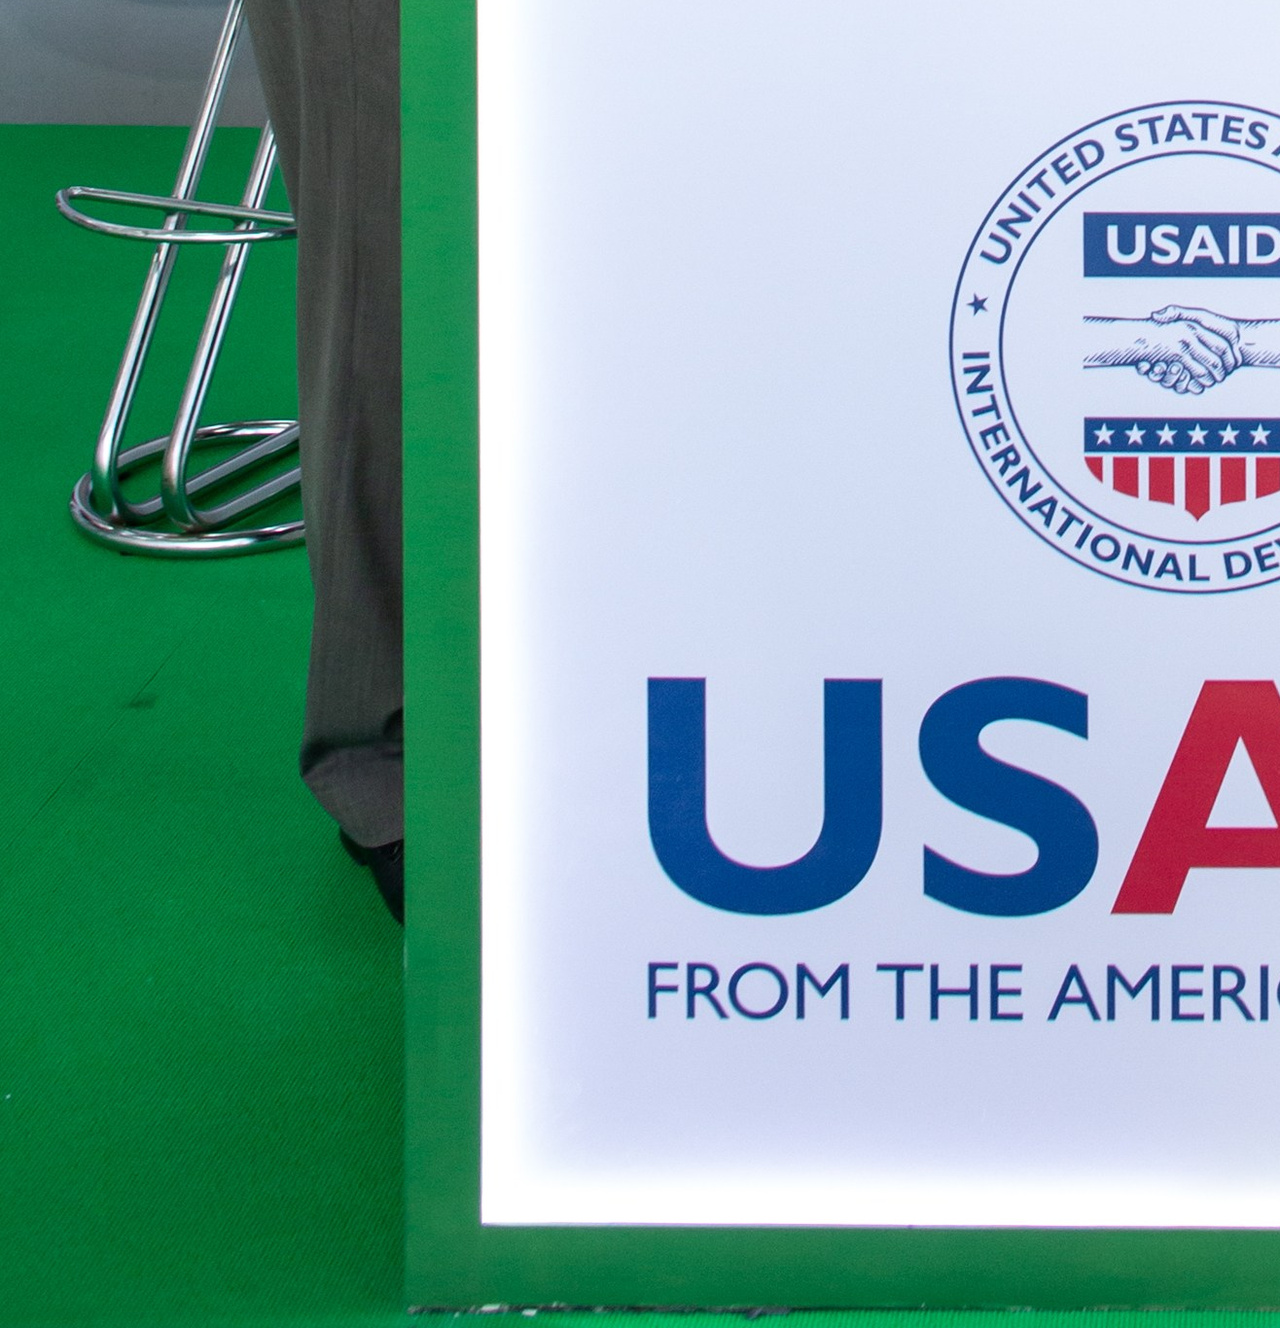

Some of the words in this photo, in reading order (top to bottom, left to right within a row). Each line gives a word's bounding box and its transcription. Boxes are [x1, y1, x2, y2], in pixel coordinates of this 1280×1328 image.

[980, 139, 1104, 266] UNITED
[1114, 112, 1269, 153] STATES
[962, 351, 1210, 581] INTERNATIONAL
[647, 962, 850, 1020] FROM
[877, 962, 1029, 1021] THE
